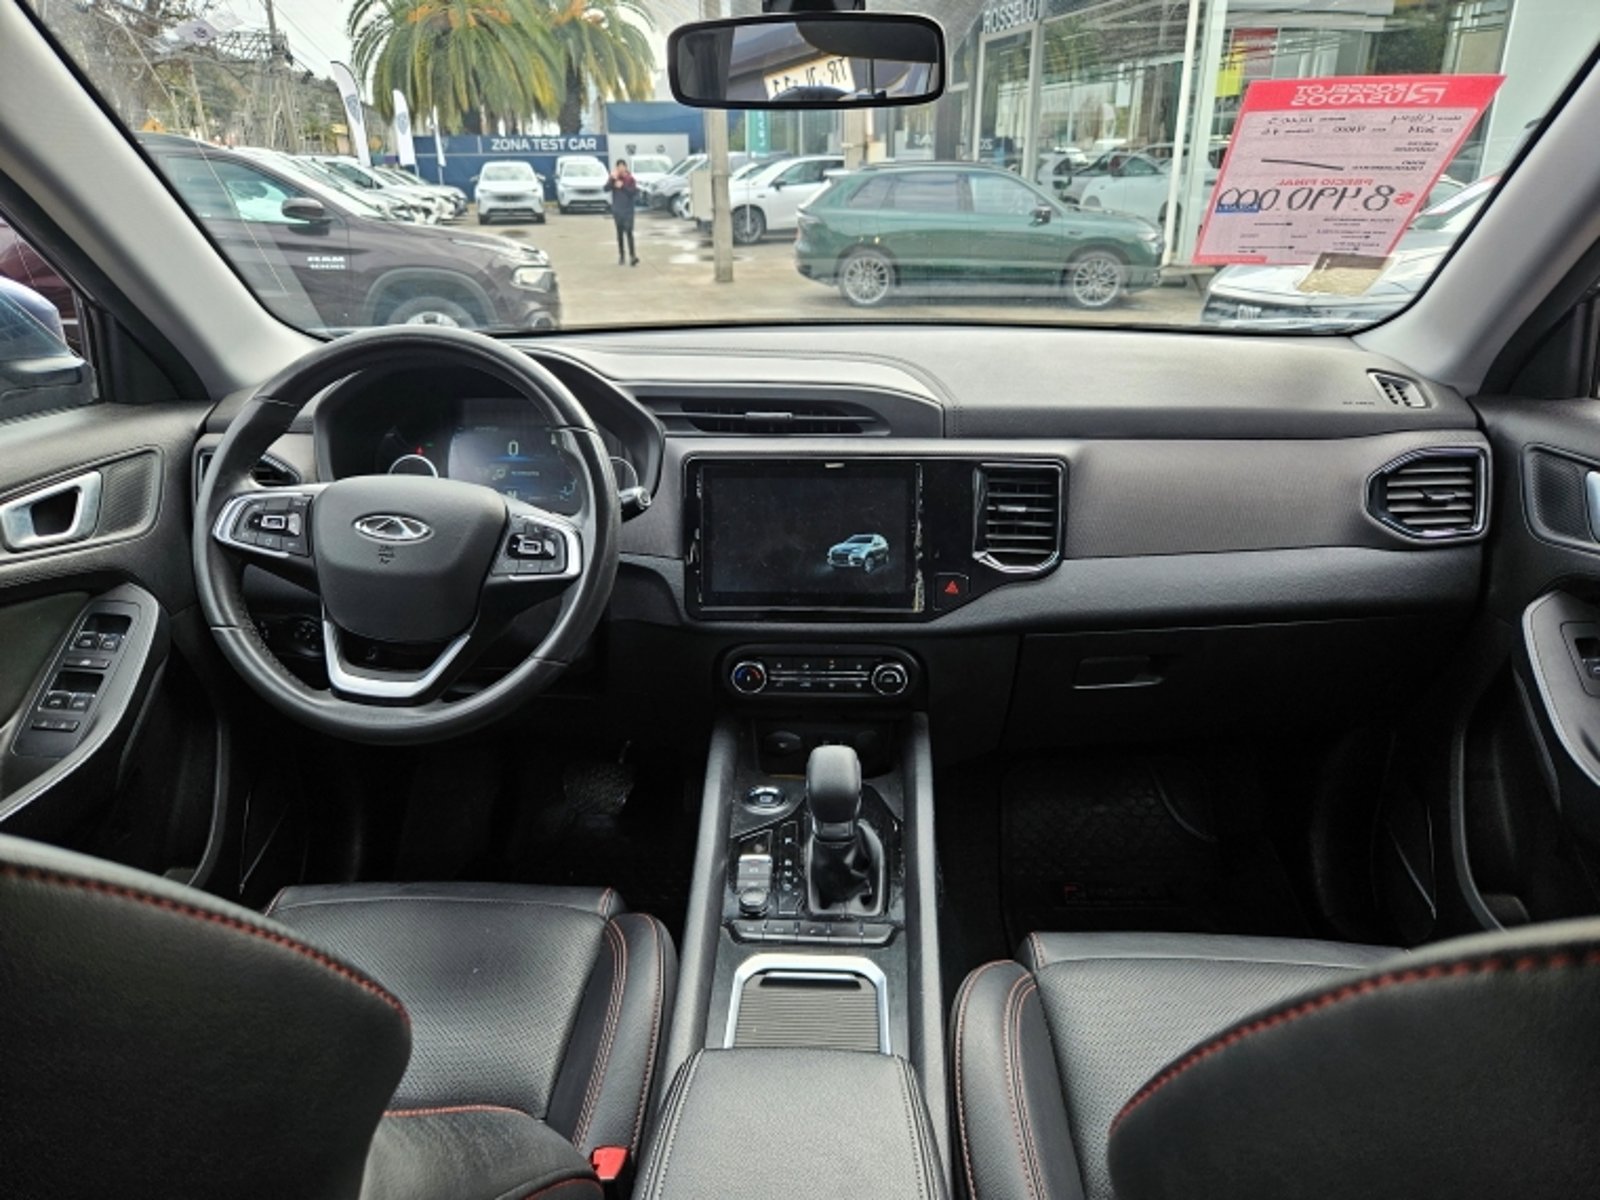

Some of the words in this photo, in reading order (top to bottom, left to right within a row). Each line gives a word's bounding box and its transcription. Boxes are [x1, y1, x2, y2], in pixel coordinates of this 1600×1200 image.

[491, 138, 530, 151] ZONA
[532, 138, 566, 151] TEST
[568, 138, 597, 151] CAR
[508, 440, 519, 457] 0
